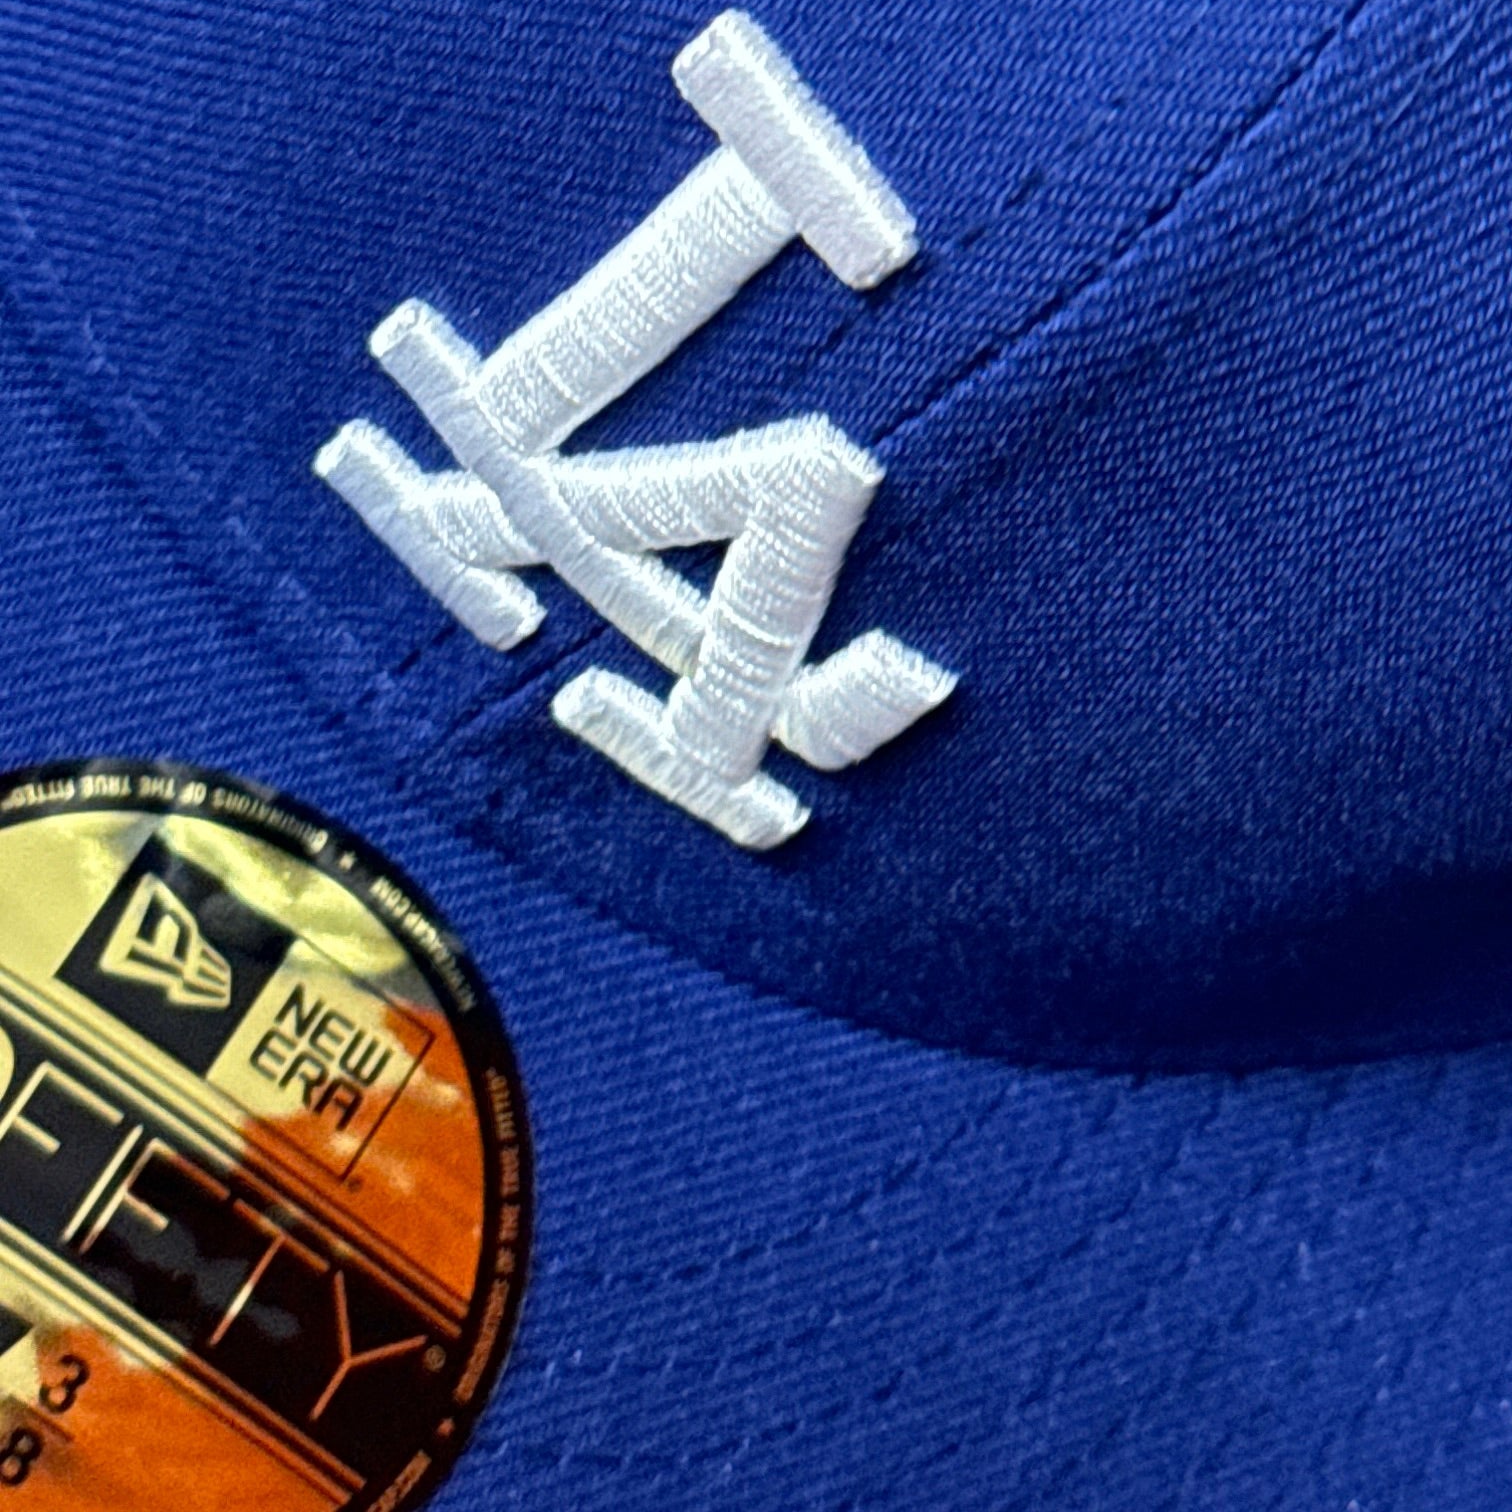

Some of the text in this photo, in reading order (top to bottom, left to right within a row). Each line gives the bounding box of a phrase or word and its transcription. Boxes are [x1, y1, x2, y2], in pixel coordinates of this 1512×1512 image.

[314, 8, 958, 850] LA
[80, 775, 133, 800] TRUE
[137, 774, 177, 800] THE
[179, 780, 207, 804] OF
[274, 984, 394, 1086] NEW
[250, 1028, 363, 1130] ERA
[0, 1026, 428, 1421] FIFTY
[38, 1354, 90, 1414] 3
[0, 1426, 44, 1486] 8
